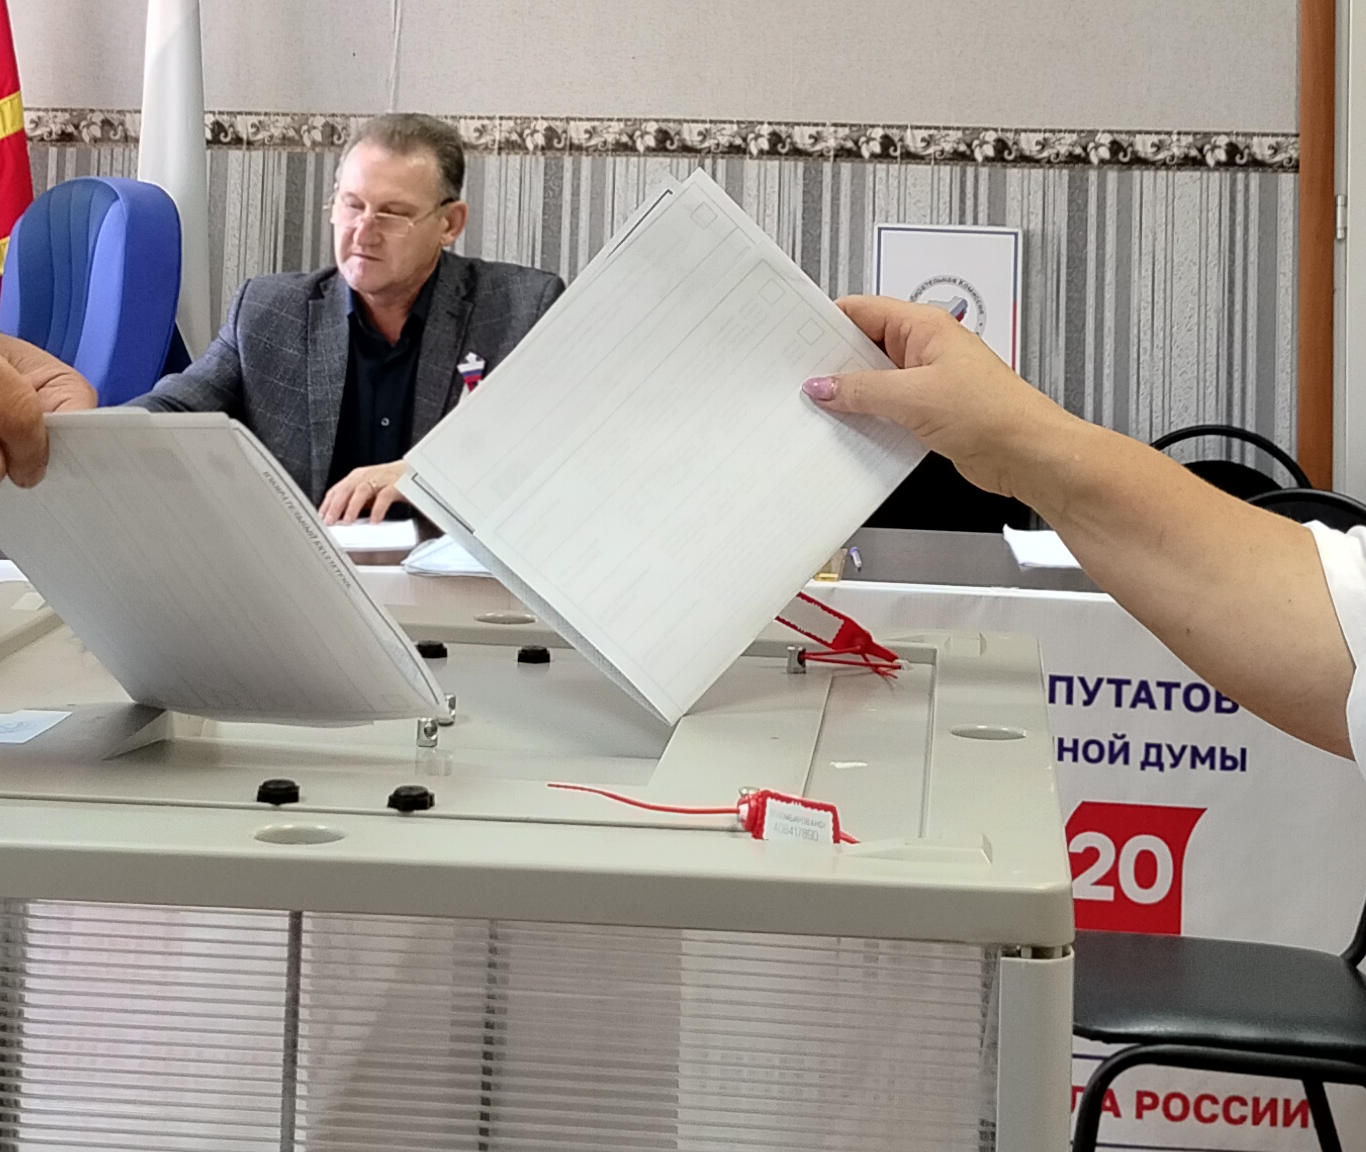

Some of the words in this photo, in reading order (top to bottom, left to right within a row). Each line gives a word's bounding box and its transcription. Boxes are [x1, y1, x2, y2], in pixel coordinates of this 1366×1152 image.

[1046, 674, 1241, 715] ПУТАТОВ
[1139, 742, 1248, 773] ДУМЫ
[1068, 831, 1175, 905] 20
[1134, 1089, 1311, 1128] РОССИИ
